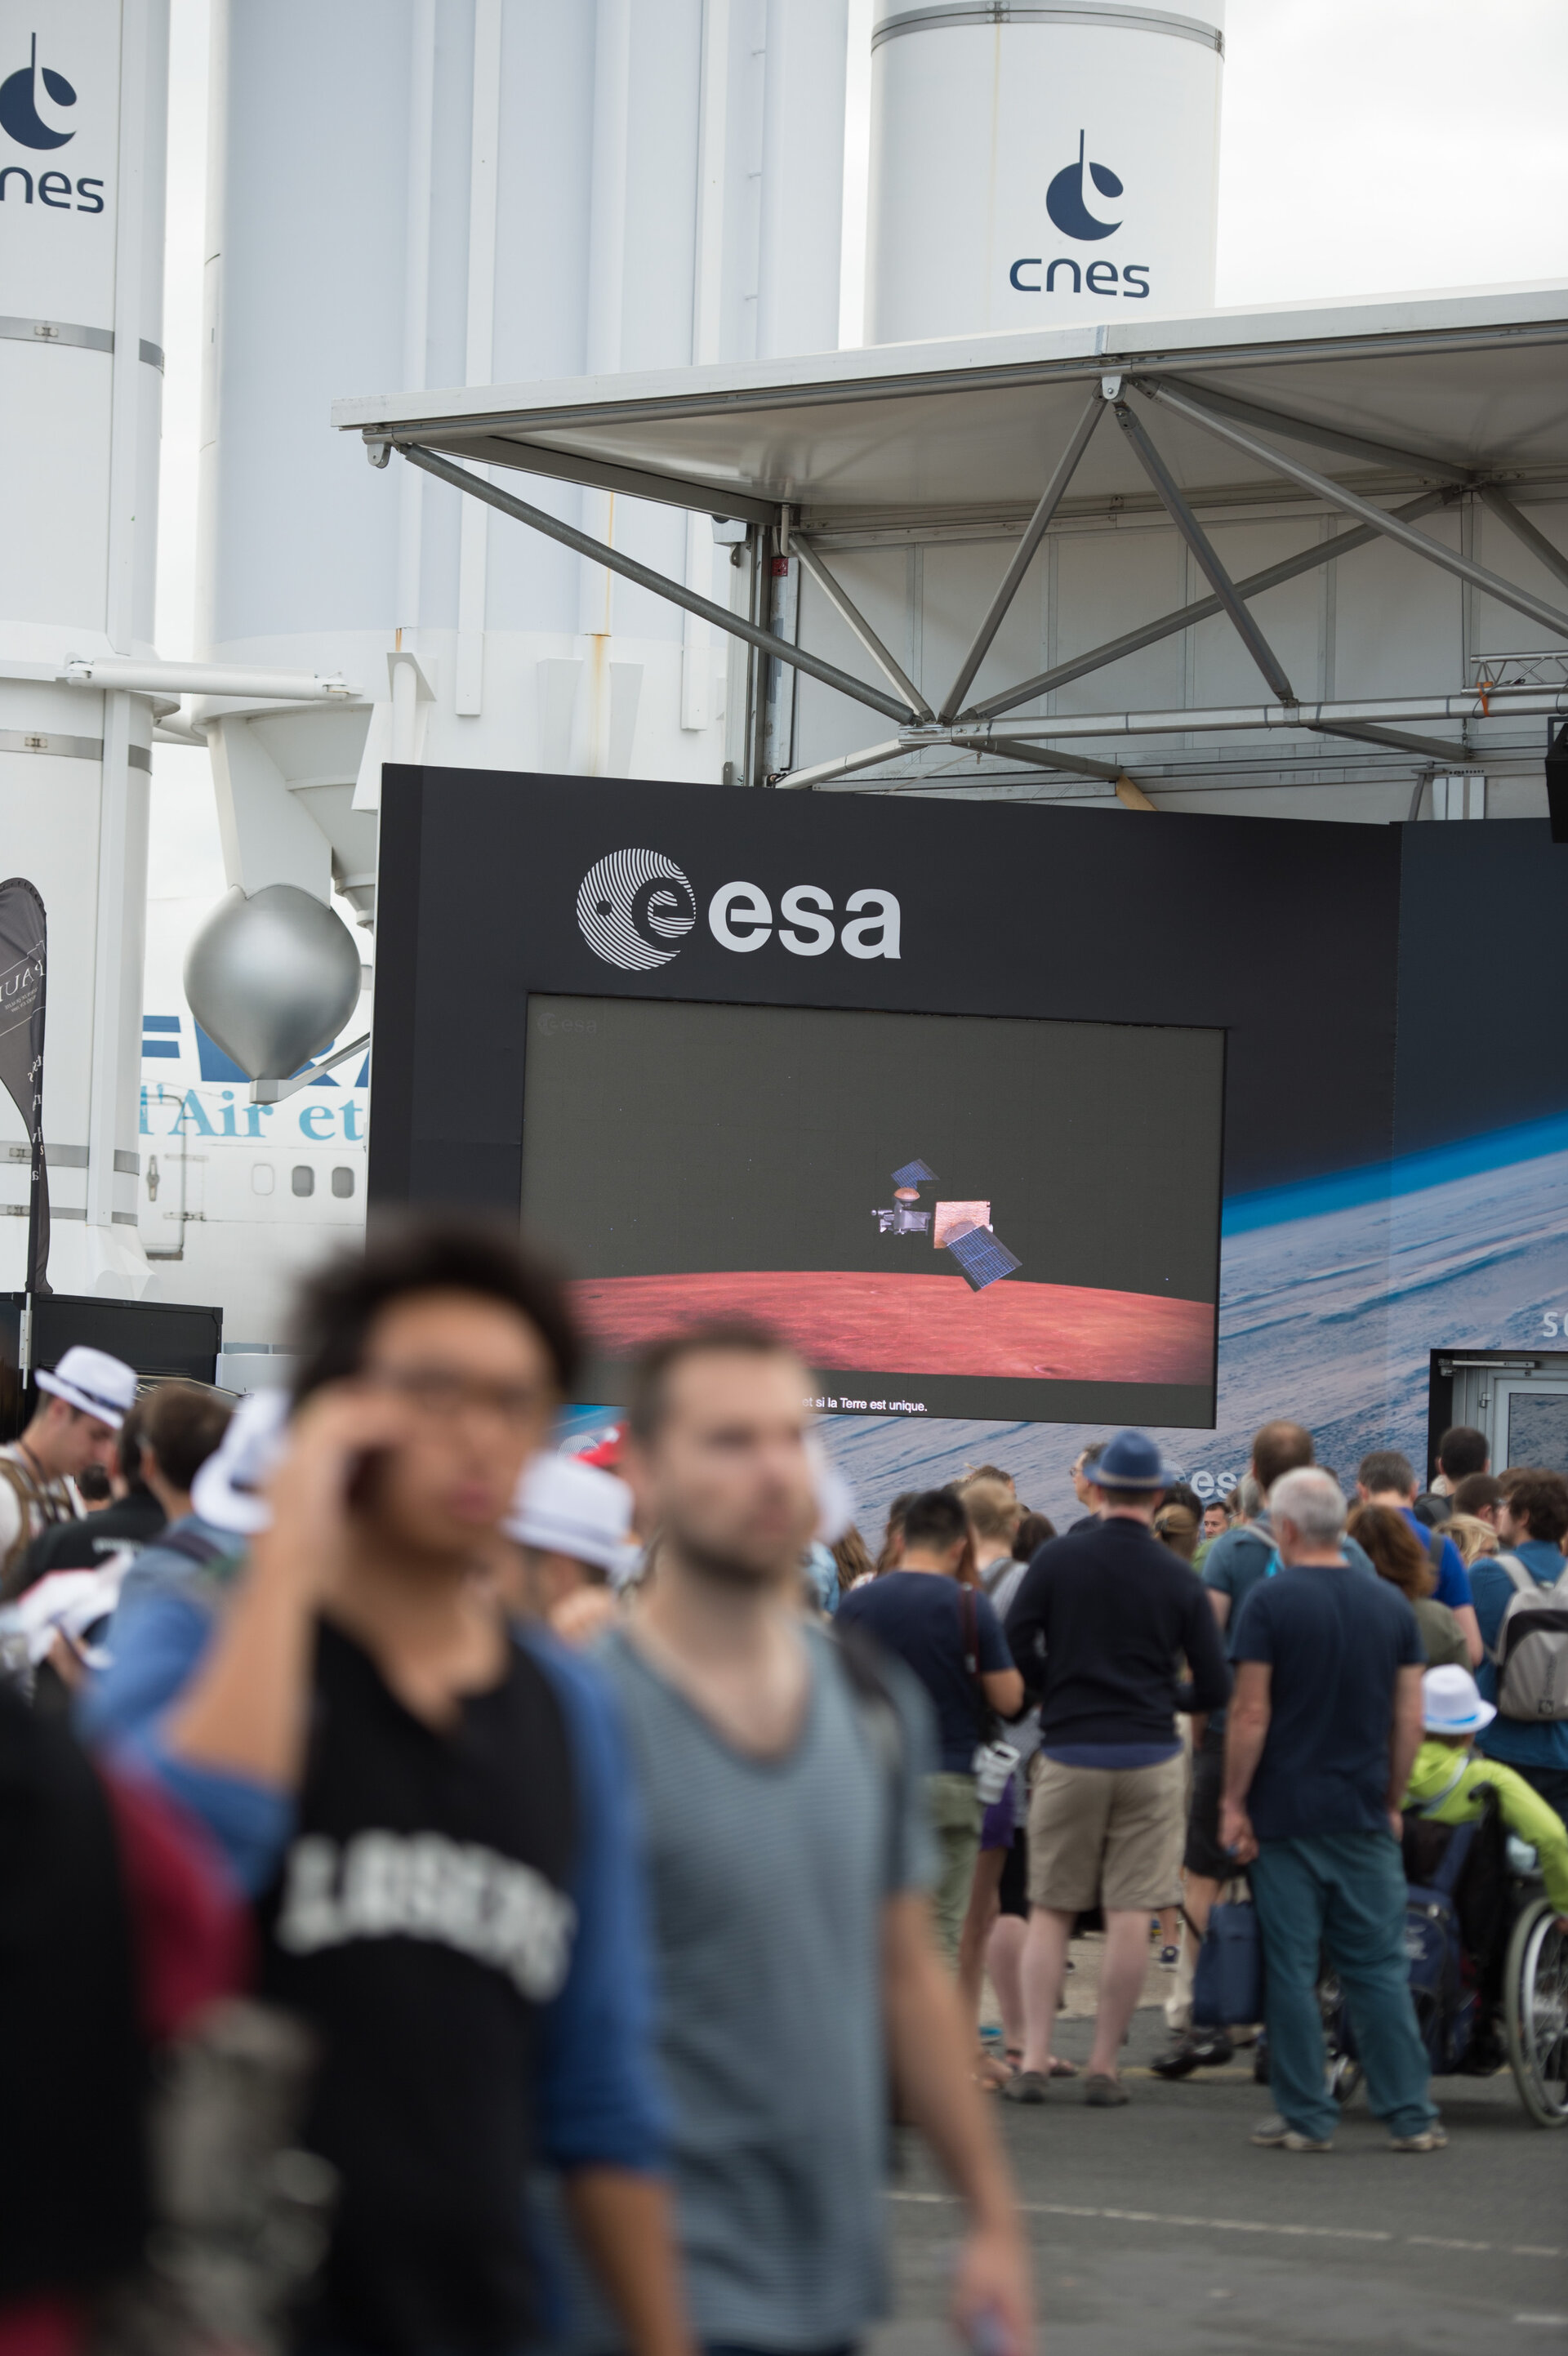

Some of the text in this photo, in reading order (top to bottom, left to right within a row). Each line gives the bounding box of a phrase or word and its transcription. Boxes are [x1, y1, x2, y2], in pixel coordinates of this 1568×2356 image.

[0, 166, 105, 214] nes
[1009, 257, 1150, 299] cnes
[707, 880, 902, 960] esa
[298, 1099, 363, 1141] et
[816, 1396, 826, 1408] si
[827, 1397, 838, 1409] la
[840, 1397, 867, 1410] Terre
[870, 1400, 886, 1410] est
[889, 1400, 928, 1414] unique.
[1191, 1471, 1238, 1499] es
